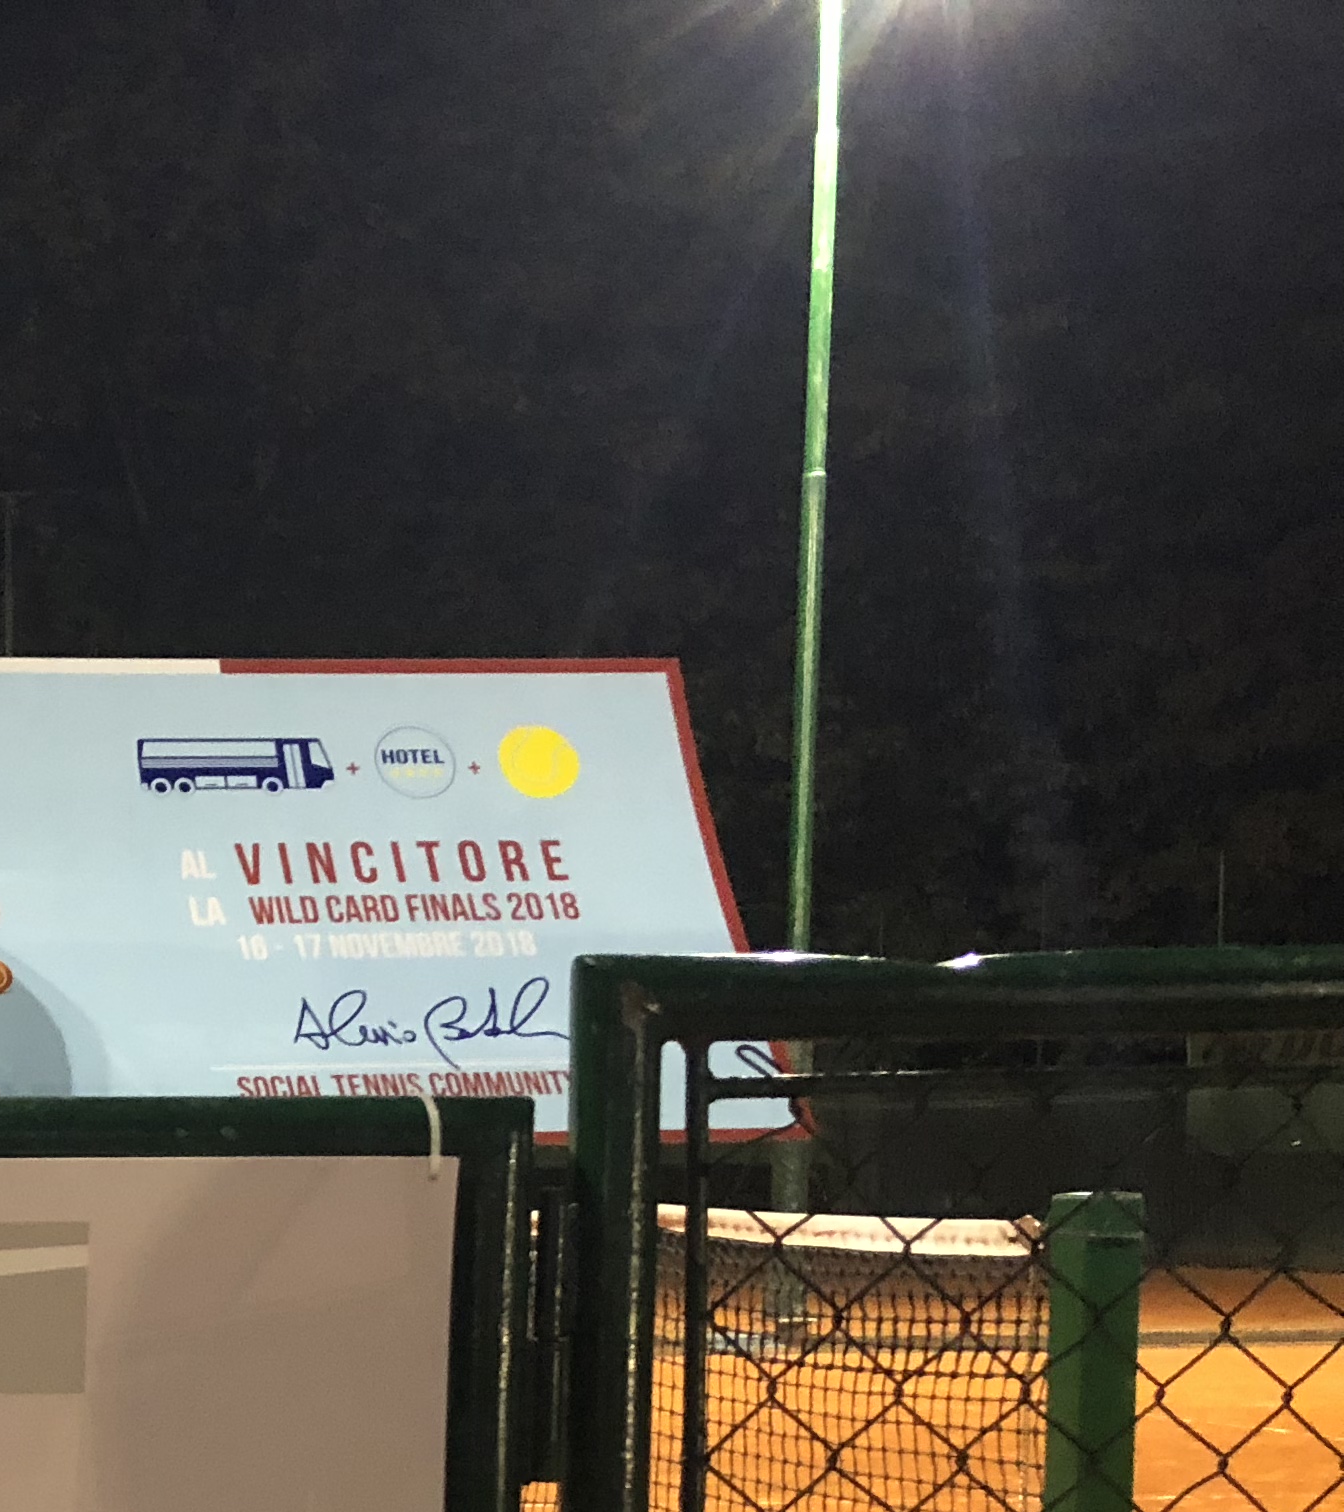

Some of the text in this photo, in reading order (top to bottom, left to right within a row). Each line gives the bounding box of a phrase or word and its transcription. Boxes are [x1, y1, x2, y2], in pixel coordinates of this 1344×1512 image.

[380, 748, 445, 764] HOTEL
[181, 840, 569, 885] AL VINCITORE
[189, 891, 581, 926] LA WILD CARD FINALS 2018
[293, 933, 322, 961] 17
[327, 931, 463, 959] NOVEMBRE
[469, 930, 538, 958] 2018
[236, 1074, 322, 1097] SOCIAL
[331, 1072, 423, 1097] TENNIS
